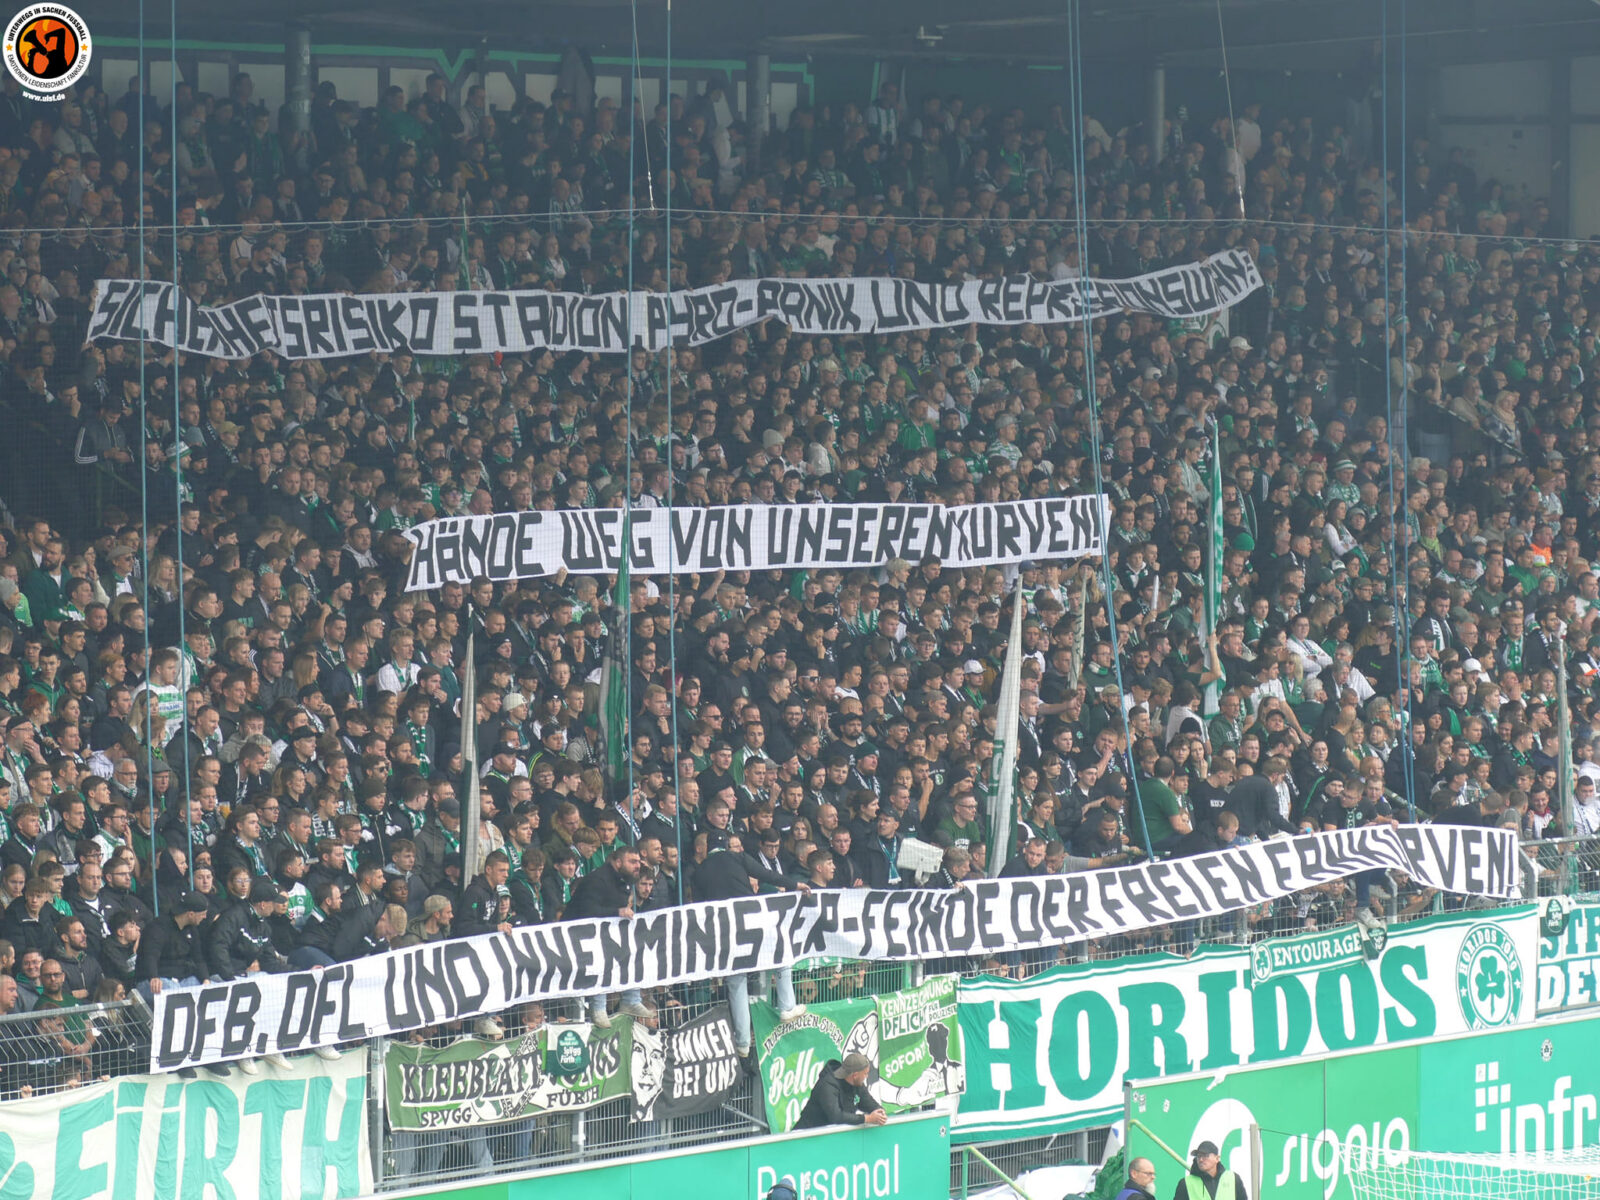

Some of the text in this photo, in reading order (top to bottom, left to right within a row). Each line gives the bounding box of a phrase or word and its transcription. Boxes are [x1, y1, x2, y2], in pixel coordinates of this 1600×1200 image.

[871, 280, 969, 327] UND
[410, 498, 1101, 586] HÄNDE WEG VON UNSEREN KURVEN!
[159, 981, 268, 1068] DFB,
[277, 963, 366, 1051] DFL
[384, 941, 489, 1031] UND
[1010, 875, 1102, 943] DER
[1096, 847, 1273, 927] FREIEN
[1273, 932, 1362, 966] ENTOURAGE
[1459, 929, 1497, 976] HORIDOS
[671, 1018, 735, 1066] IMMER
[957, 944, 1437, 1112] HORIDOS
[546, 1085, 601, 1110] FÜRTH
[673, 1057, 738, 1099] BEI UNS
[52, 1076, 366, 1200] FÜRTH
[1276, 1117, 1410, 1200] signia
